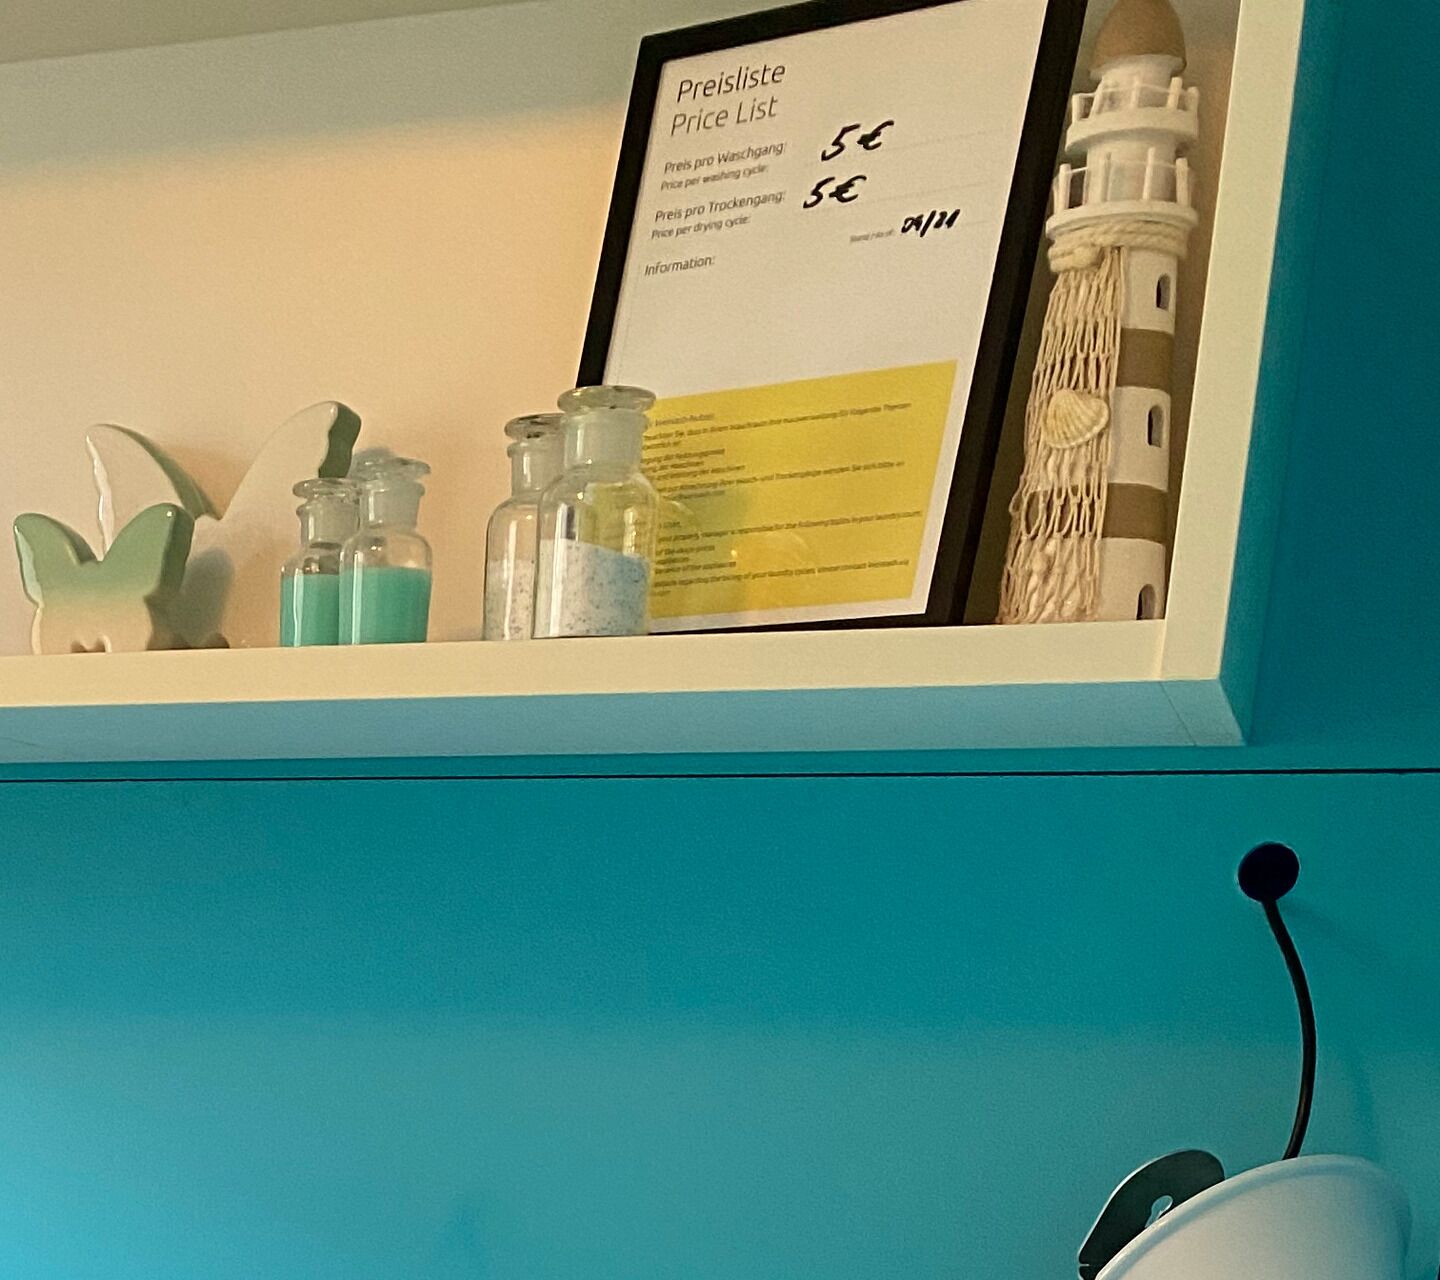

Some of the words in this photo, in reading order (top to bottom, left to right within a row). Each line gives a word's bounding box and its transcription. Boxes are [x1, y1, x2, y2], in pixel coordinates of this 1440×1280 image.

[676, 63, 786, 103] Preisliste
[671, 109, 729, 137] Price
[736, 96, 778, 125] List
[664, 160, 692, 174] Preis
[694, 156, 715, 171] pro
[717, 142, 788, 164] Waschgang:
[661, 180, 683, 191] Price
[685, 177, 700, 188] per
[655, 209, 682, 222] Preis
[685, 206, 705, 219] pro
[709, 190, 787, 213] Trockengang:
[651, 228, 674, 239] Price
[675, 225, 692, 237] per
[644, 255, 715, 276] Information:
